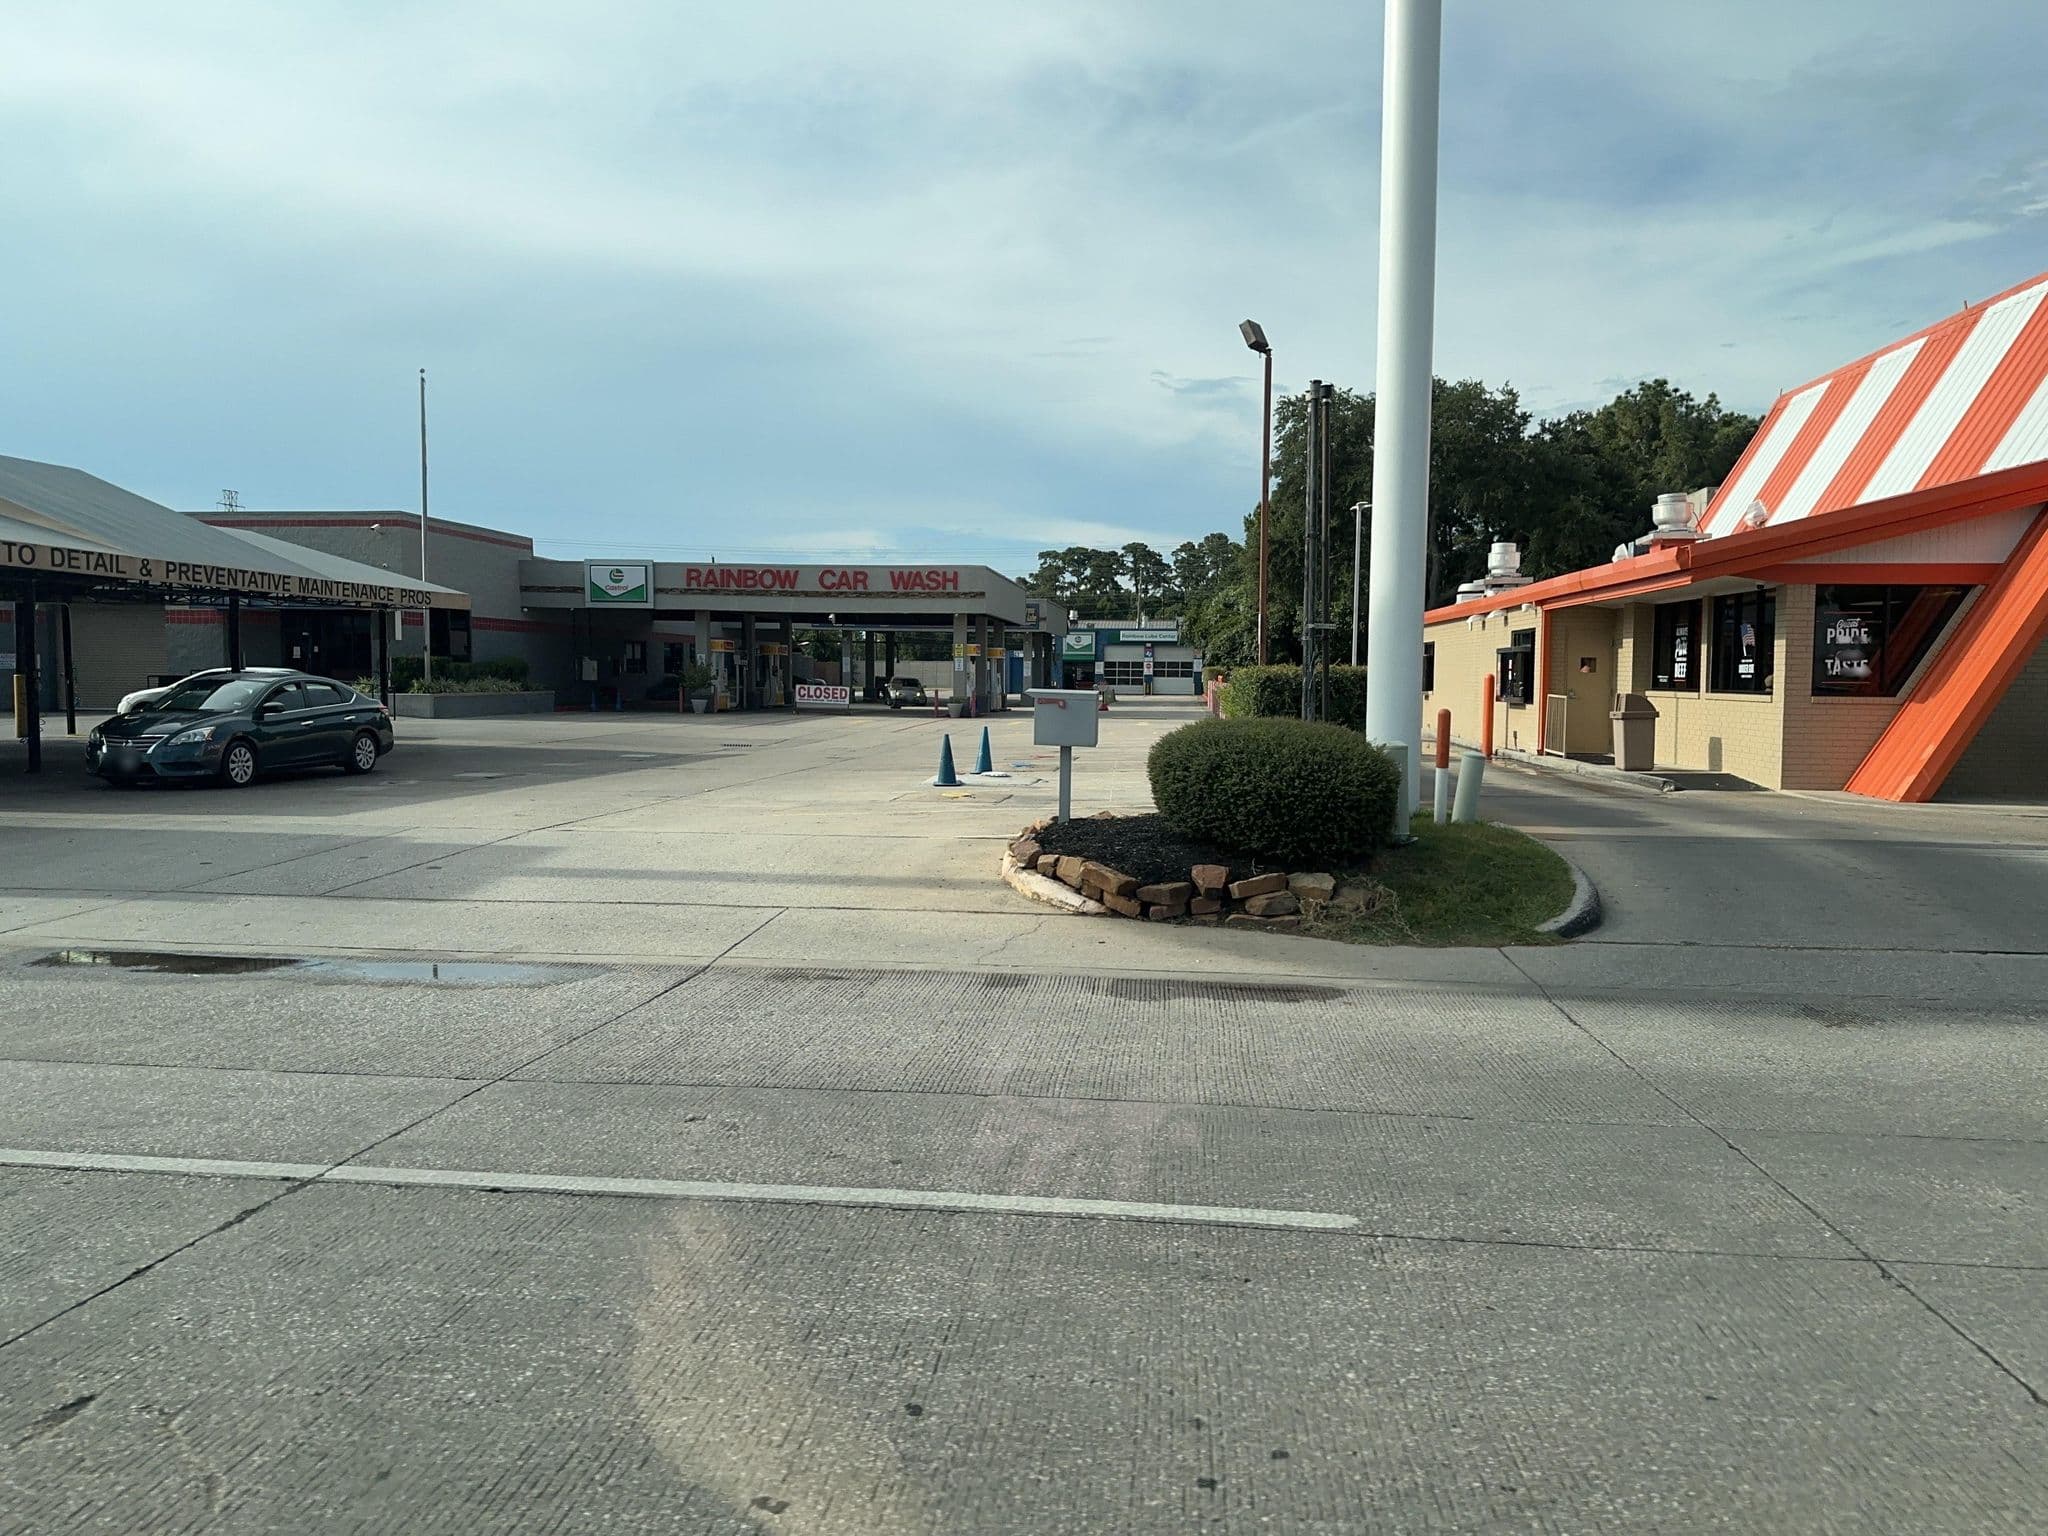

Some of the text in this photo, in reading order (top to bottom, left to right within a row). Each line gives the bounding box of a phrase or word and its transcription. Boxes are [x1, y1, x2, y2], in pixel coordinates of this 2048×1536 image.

[51, 547, 126, 574] DETAIL
[139, 558, 152, 577] &
[166, 561, 291, 592] PREVENTATIVE
[299, 577, 394, 602] MAINTENANCE
[400, 588, 432, 605] PROS
[685, 568, 959, 591] RAINBOW CAR WASH
[797, 686, 848, 700] CLOSED
